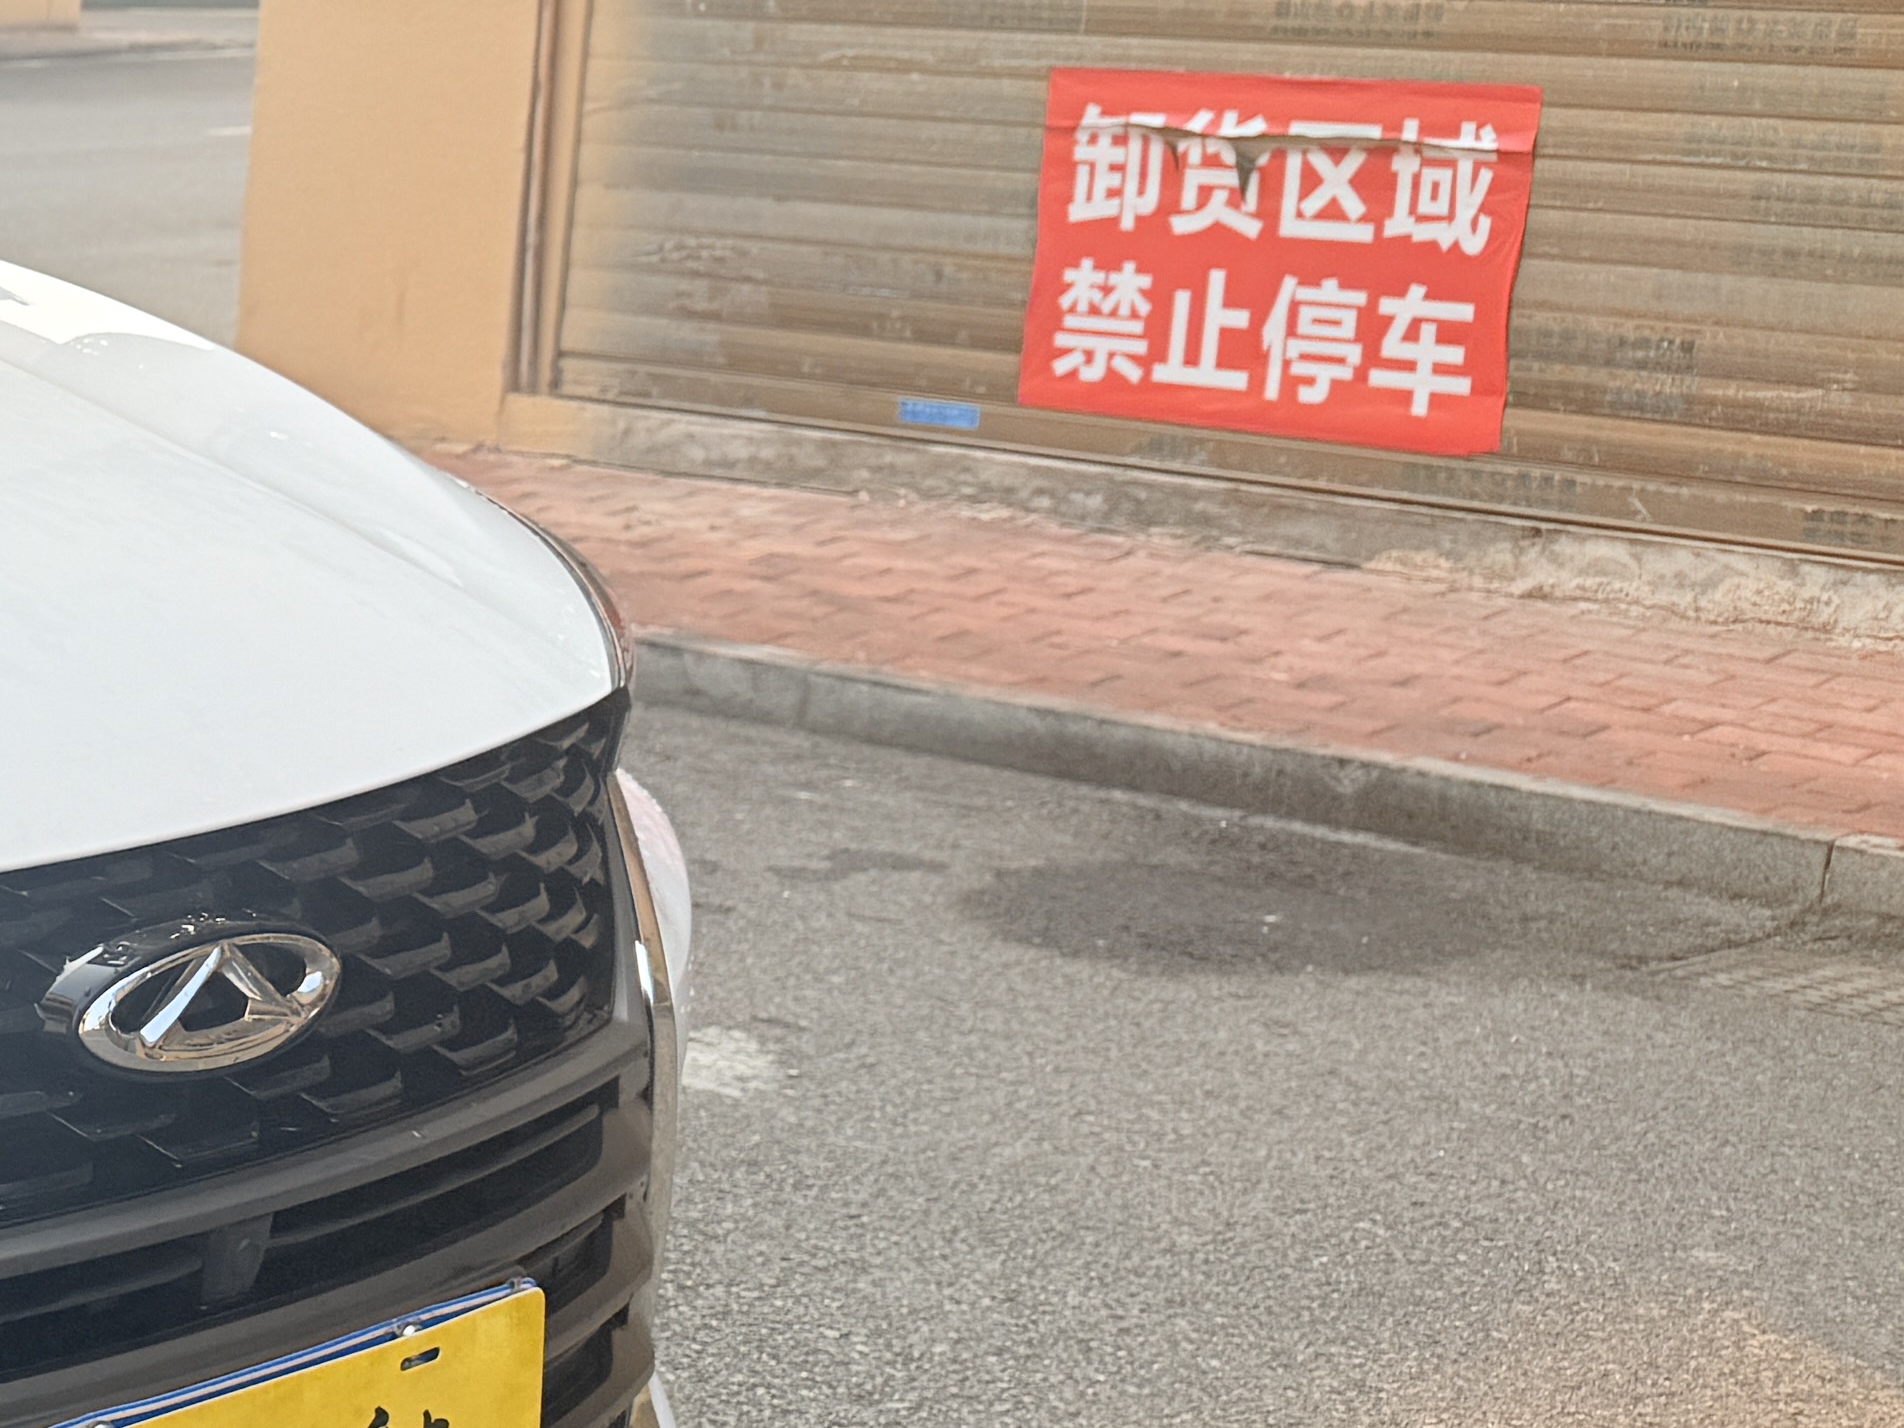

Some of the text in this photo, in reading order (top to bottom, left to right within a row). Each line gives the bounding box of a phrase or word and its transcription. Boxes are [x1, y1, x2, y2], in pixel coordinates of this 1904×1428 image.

[1067, 103, 1499, 256] 卸货区域
[1050, 257, 1475, 419] 禁止停车
